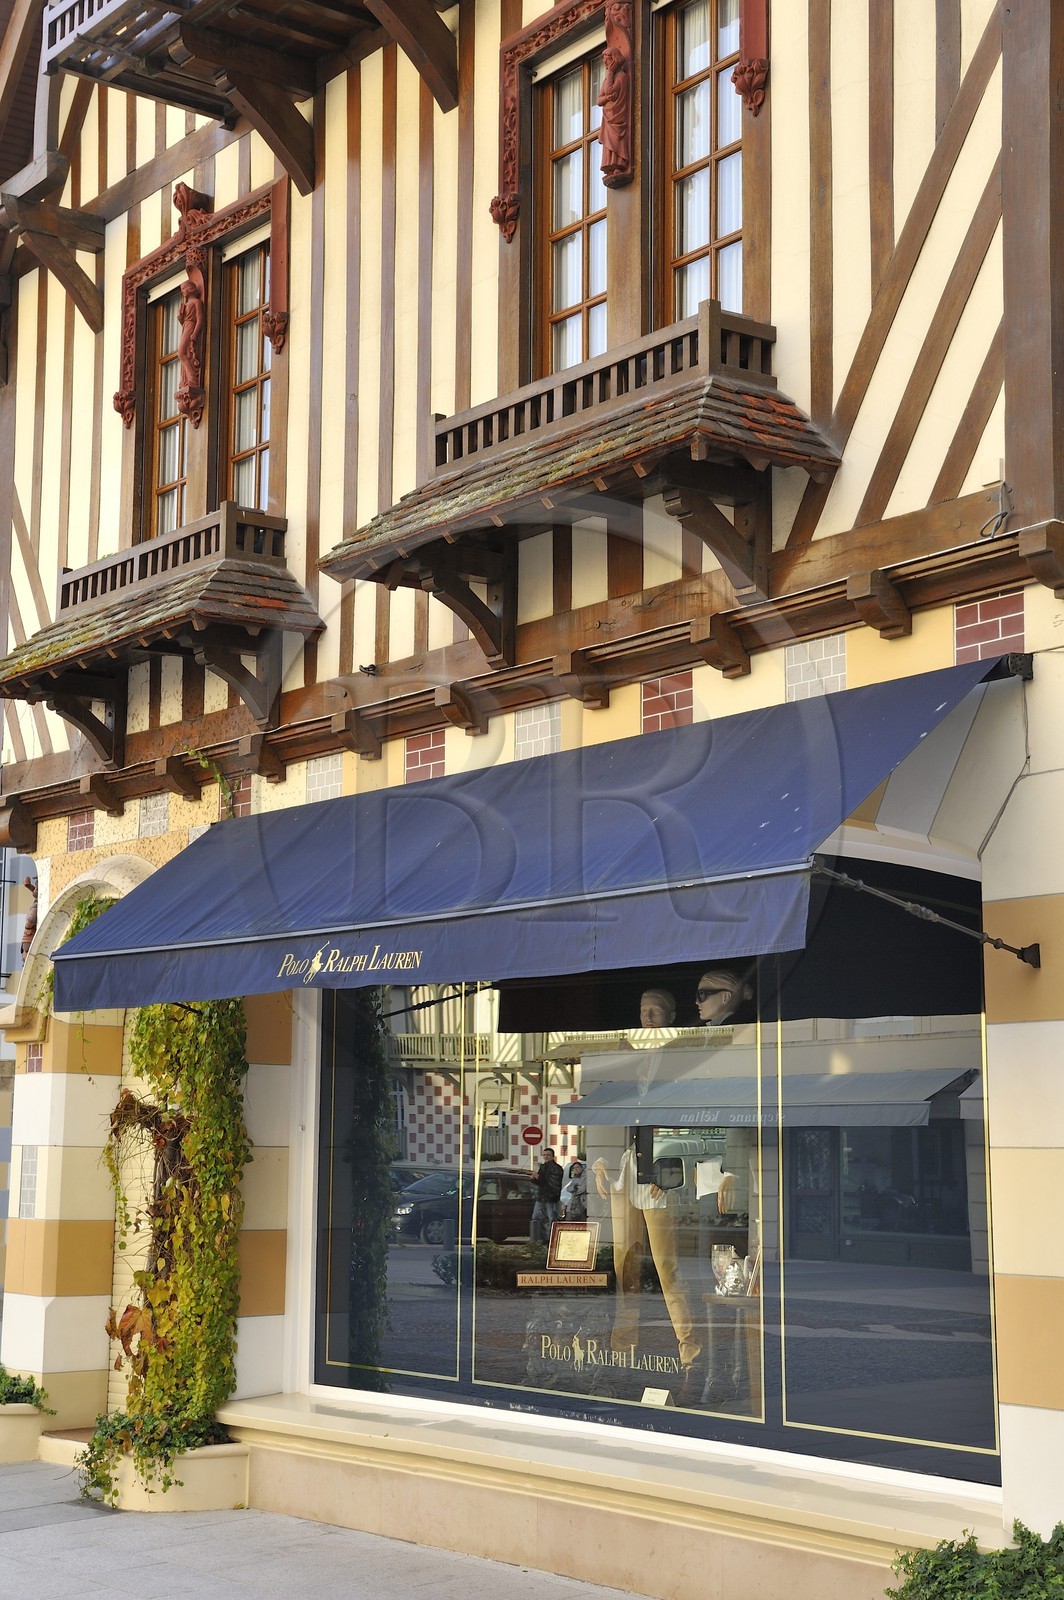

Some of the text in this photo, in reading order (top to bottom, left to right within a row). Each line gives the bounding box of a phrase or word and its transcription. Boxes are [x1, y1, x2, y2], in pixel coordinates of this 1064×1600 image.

[277, 944, 423, 978] POLO RALPH LAUREN
[521, 1276, 596, 1284] RALPH LAUREN
[541, 1335, 679, 1374] POLO RALPH LAUREN
